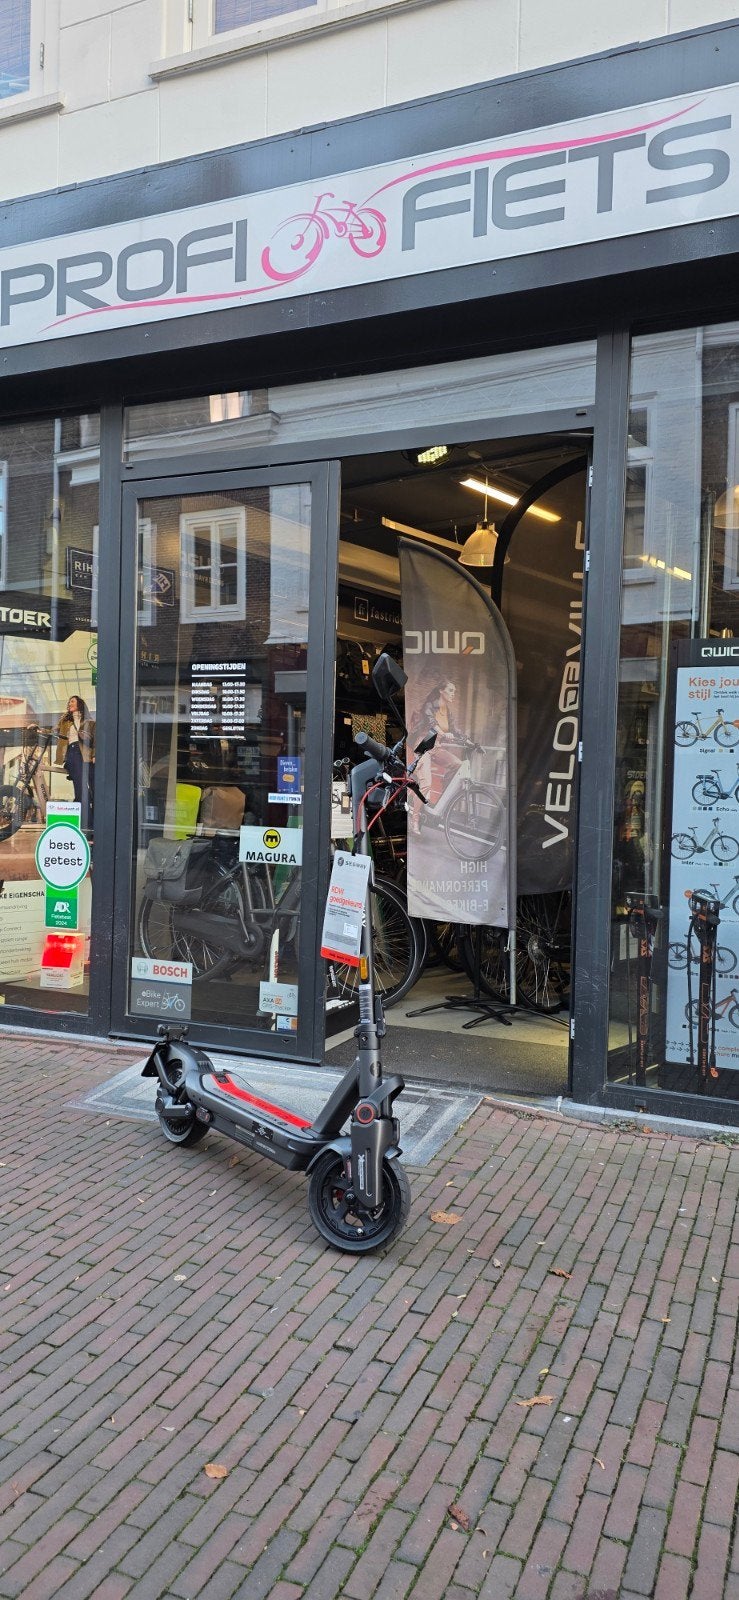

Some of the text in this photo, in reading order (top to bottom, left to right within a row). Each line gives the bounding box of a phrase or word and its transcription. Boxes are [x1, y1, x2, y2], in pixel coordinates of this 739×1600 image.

[0, 114, 732, 326] PROFI FIETS
[701, 646, 739, 657] QWIC
[689, 677, 716, 687] Kies
[688, 689, 711, 701] stijl
[49, 839, 76, 851] best
[44, 856, 83, 868] getest
[245, 851, 297, 863] MAGURA
[152, 964, 188, 978] BOSCH
[141, 990, 162, 999] eBike
[136, 999, 160, 1008] Expert
